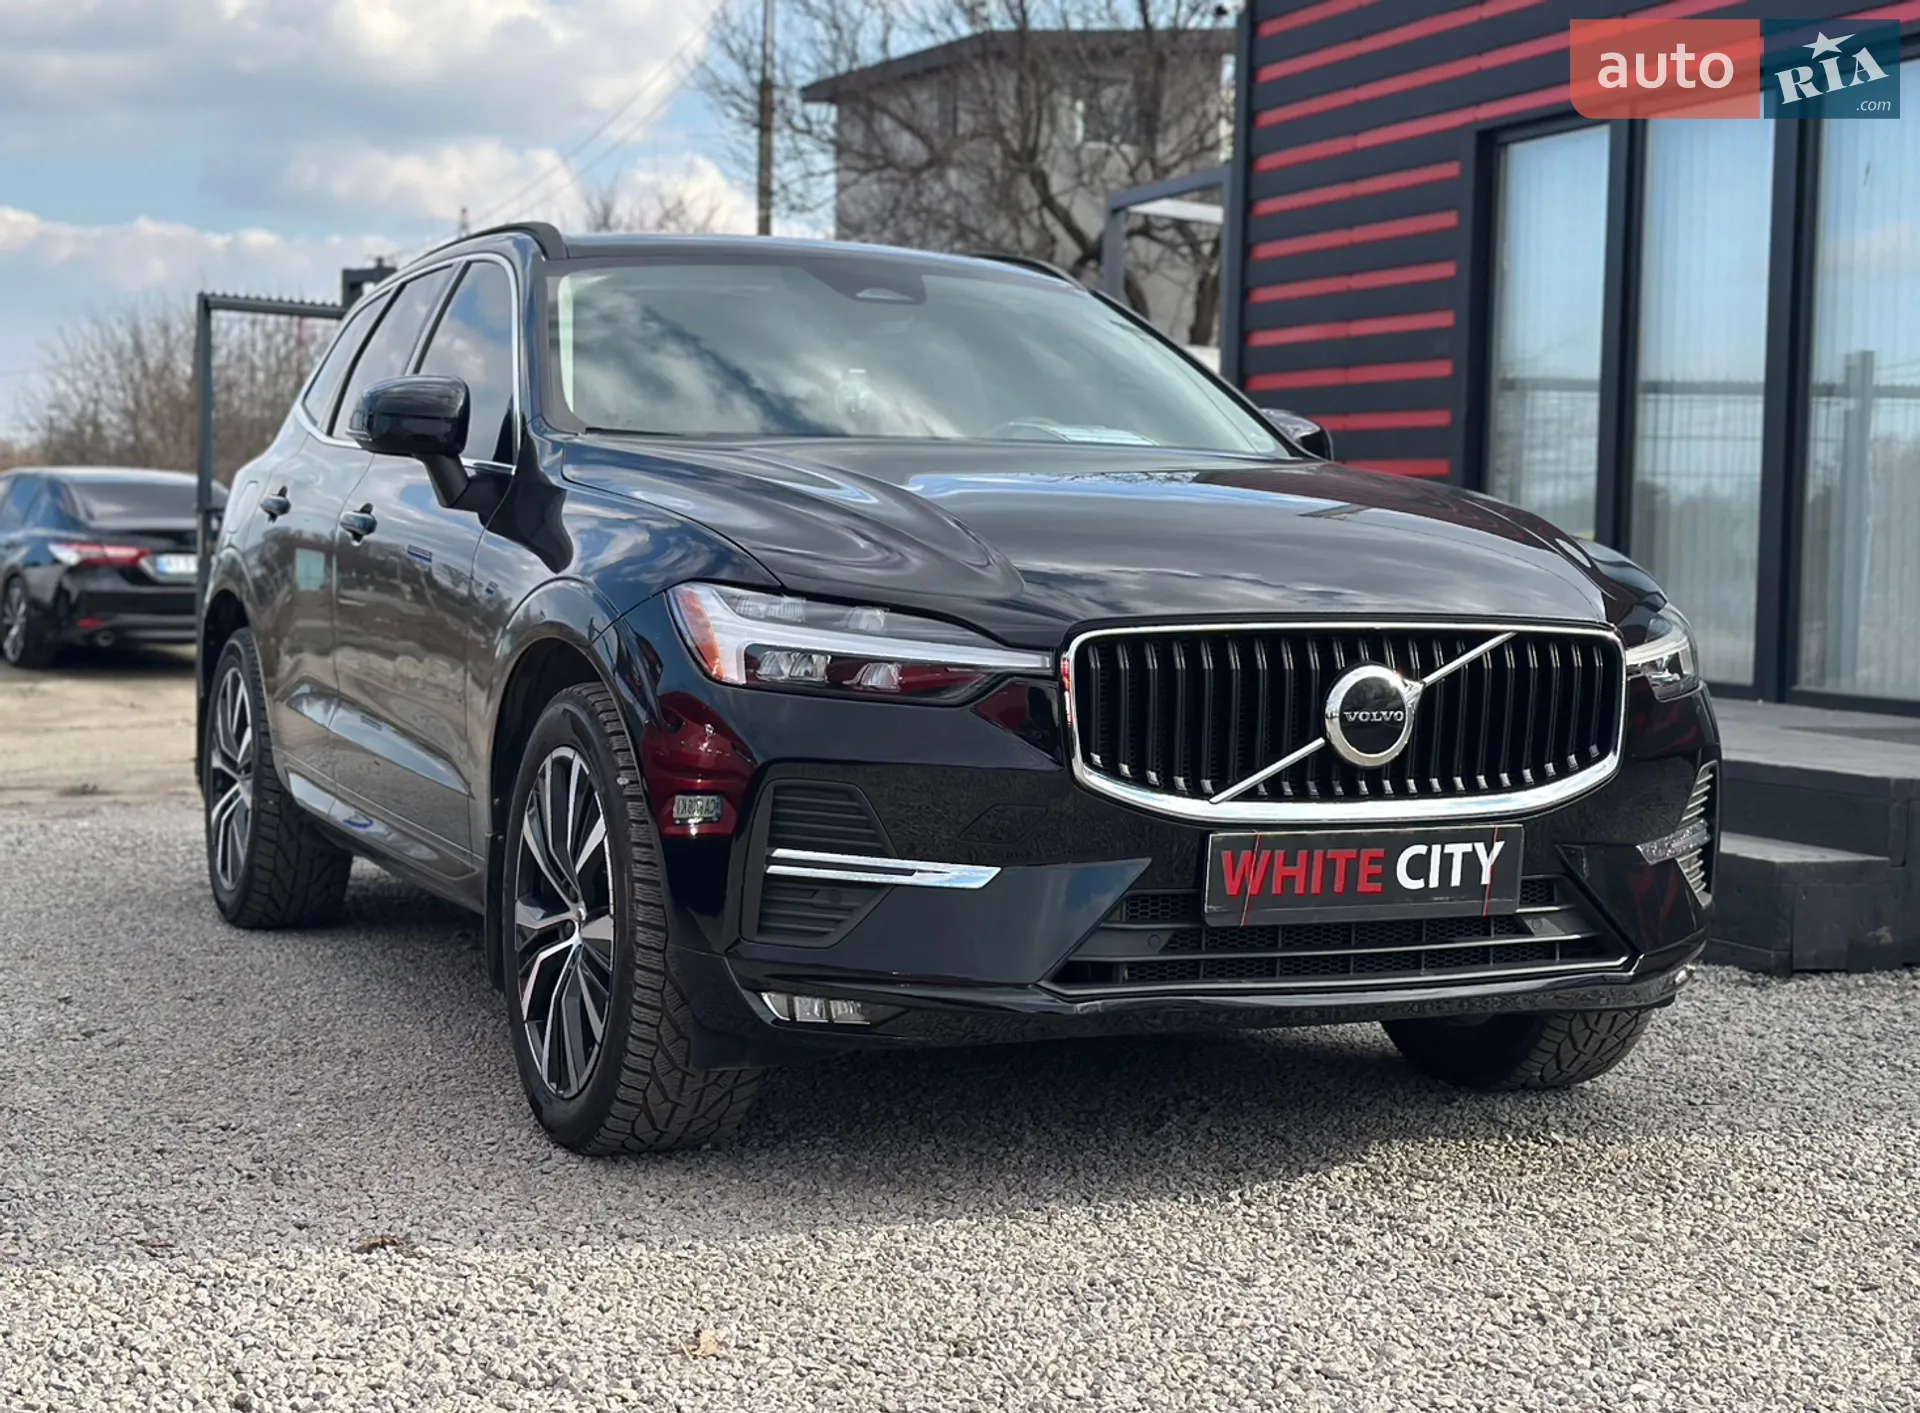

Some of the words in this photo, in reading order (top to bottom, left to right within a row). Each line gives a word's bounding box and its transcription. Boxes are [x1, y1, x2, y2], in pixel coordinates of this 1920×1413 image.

[1343, 710, 1404, 722] VOLVO
[1221, 848, 1386, 897] WHITE
[1396, 841, 1505, 890] CITY
